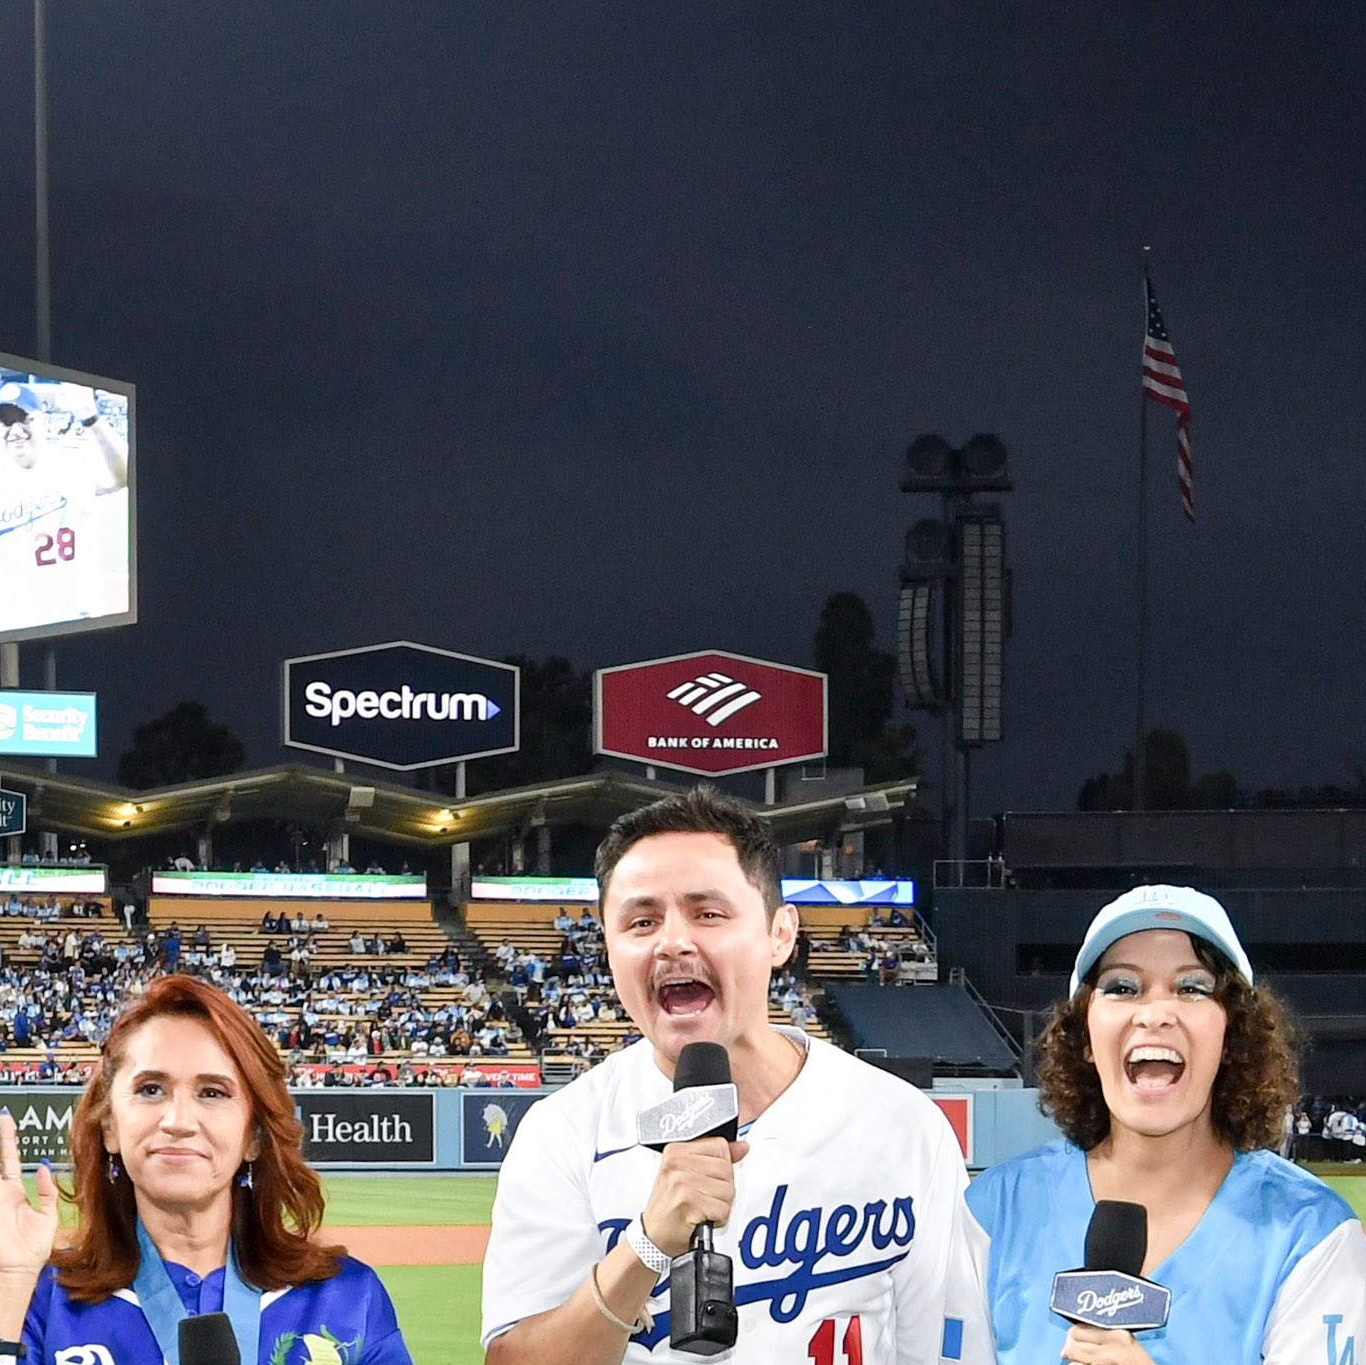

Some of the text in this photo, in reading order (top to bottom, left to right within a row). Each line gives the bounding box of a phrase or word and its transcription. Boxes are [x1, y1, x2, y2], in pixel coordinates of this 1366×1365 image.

[34, 527, 76, 567] 28
[305, 681, 488, 726] Spectrum
[647, 736, 780, 750] BANK OF AMERICA
[512, 1071, 536, 1081] TIME
[309, 1113, 413, 1144] Health
[658, 1091, 716, 1139] Dodgers
[33, 1148, 55, 1156] SAN
[1076, 1284, 1145, 1316] Dodgers
